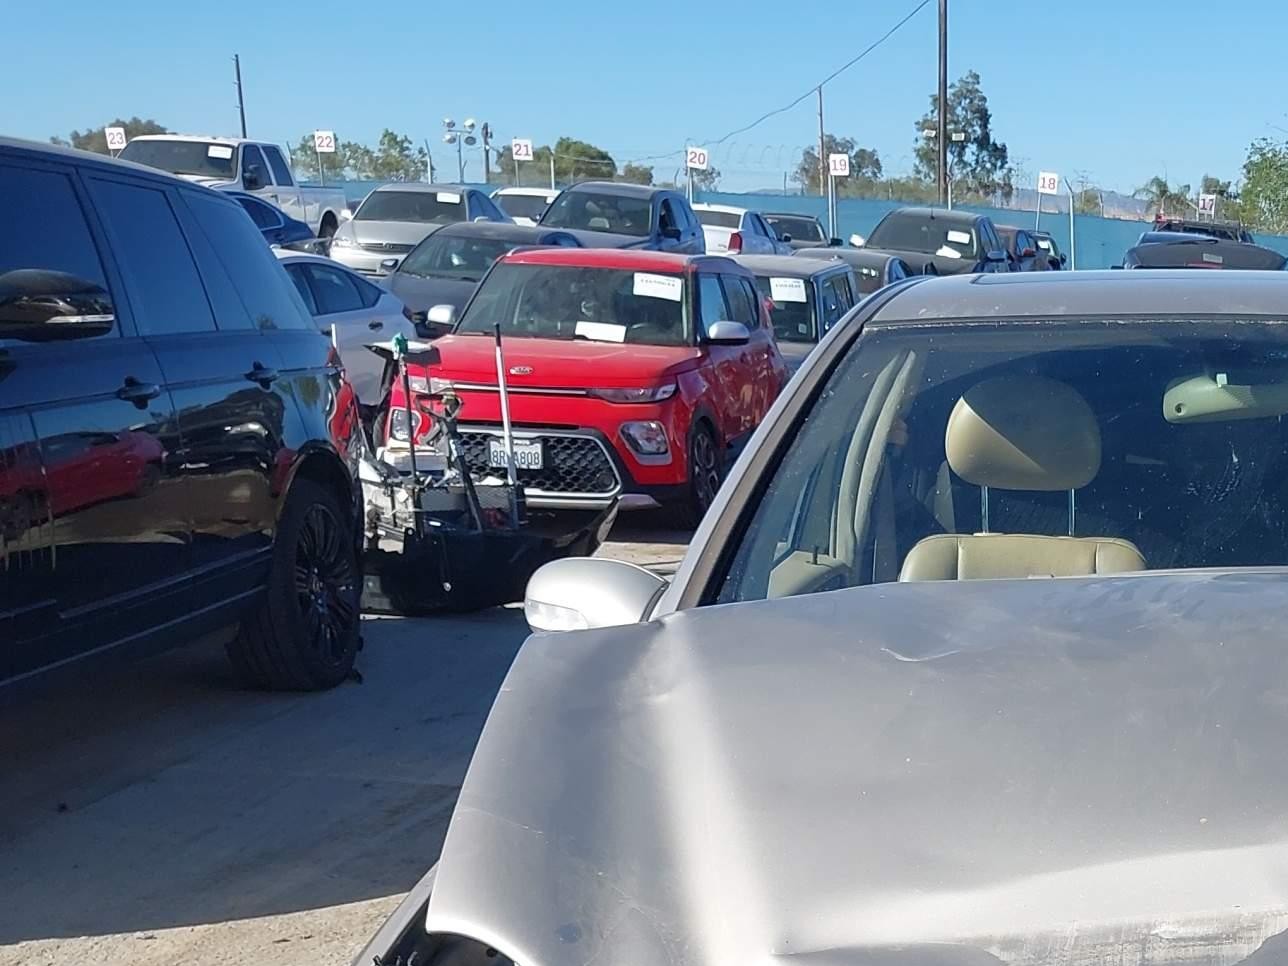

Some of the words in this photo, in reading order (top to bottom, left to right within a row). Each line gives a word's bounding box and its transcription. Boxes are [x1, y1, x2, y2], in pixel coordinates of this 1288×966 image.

[108, 131, 125, 145] 23
[316, 134, 334, 149] 22
[513, 143, 532, 157] 21
[688, 151, 706, 165] 20
[830, 158, 847, 172] 19
[1039, 176, 1056, 190] 18
[1199, 198, 1214, 211] 17
[491, 449, 540, 465] 8RA808
